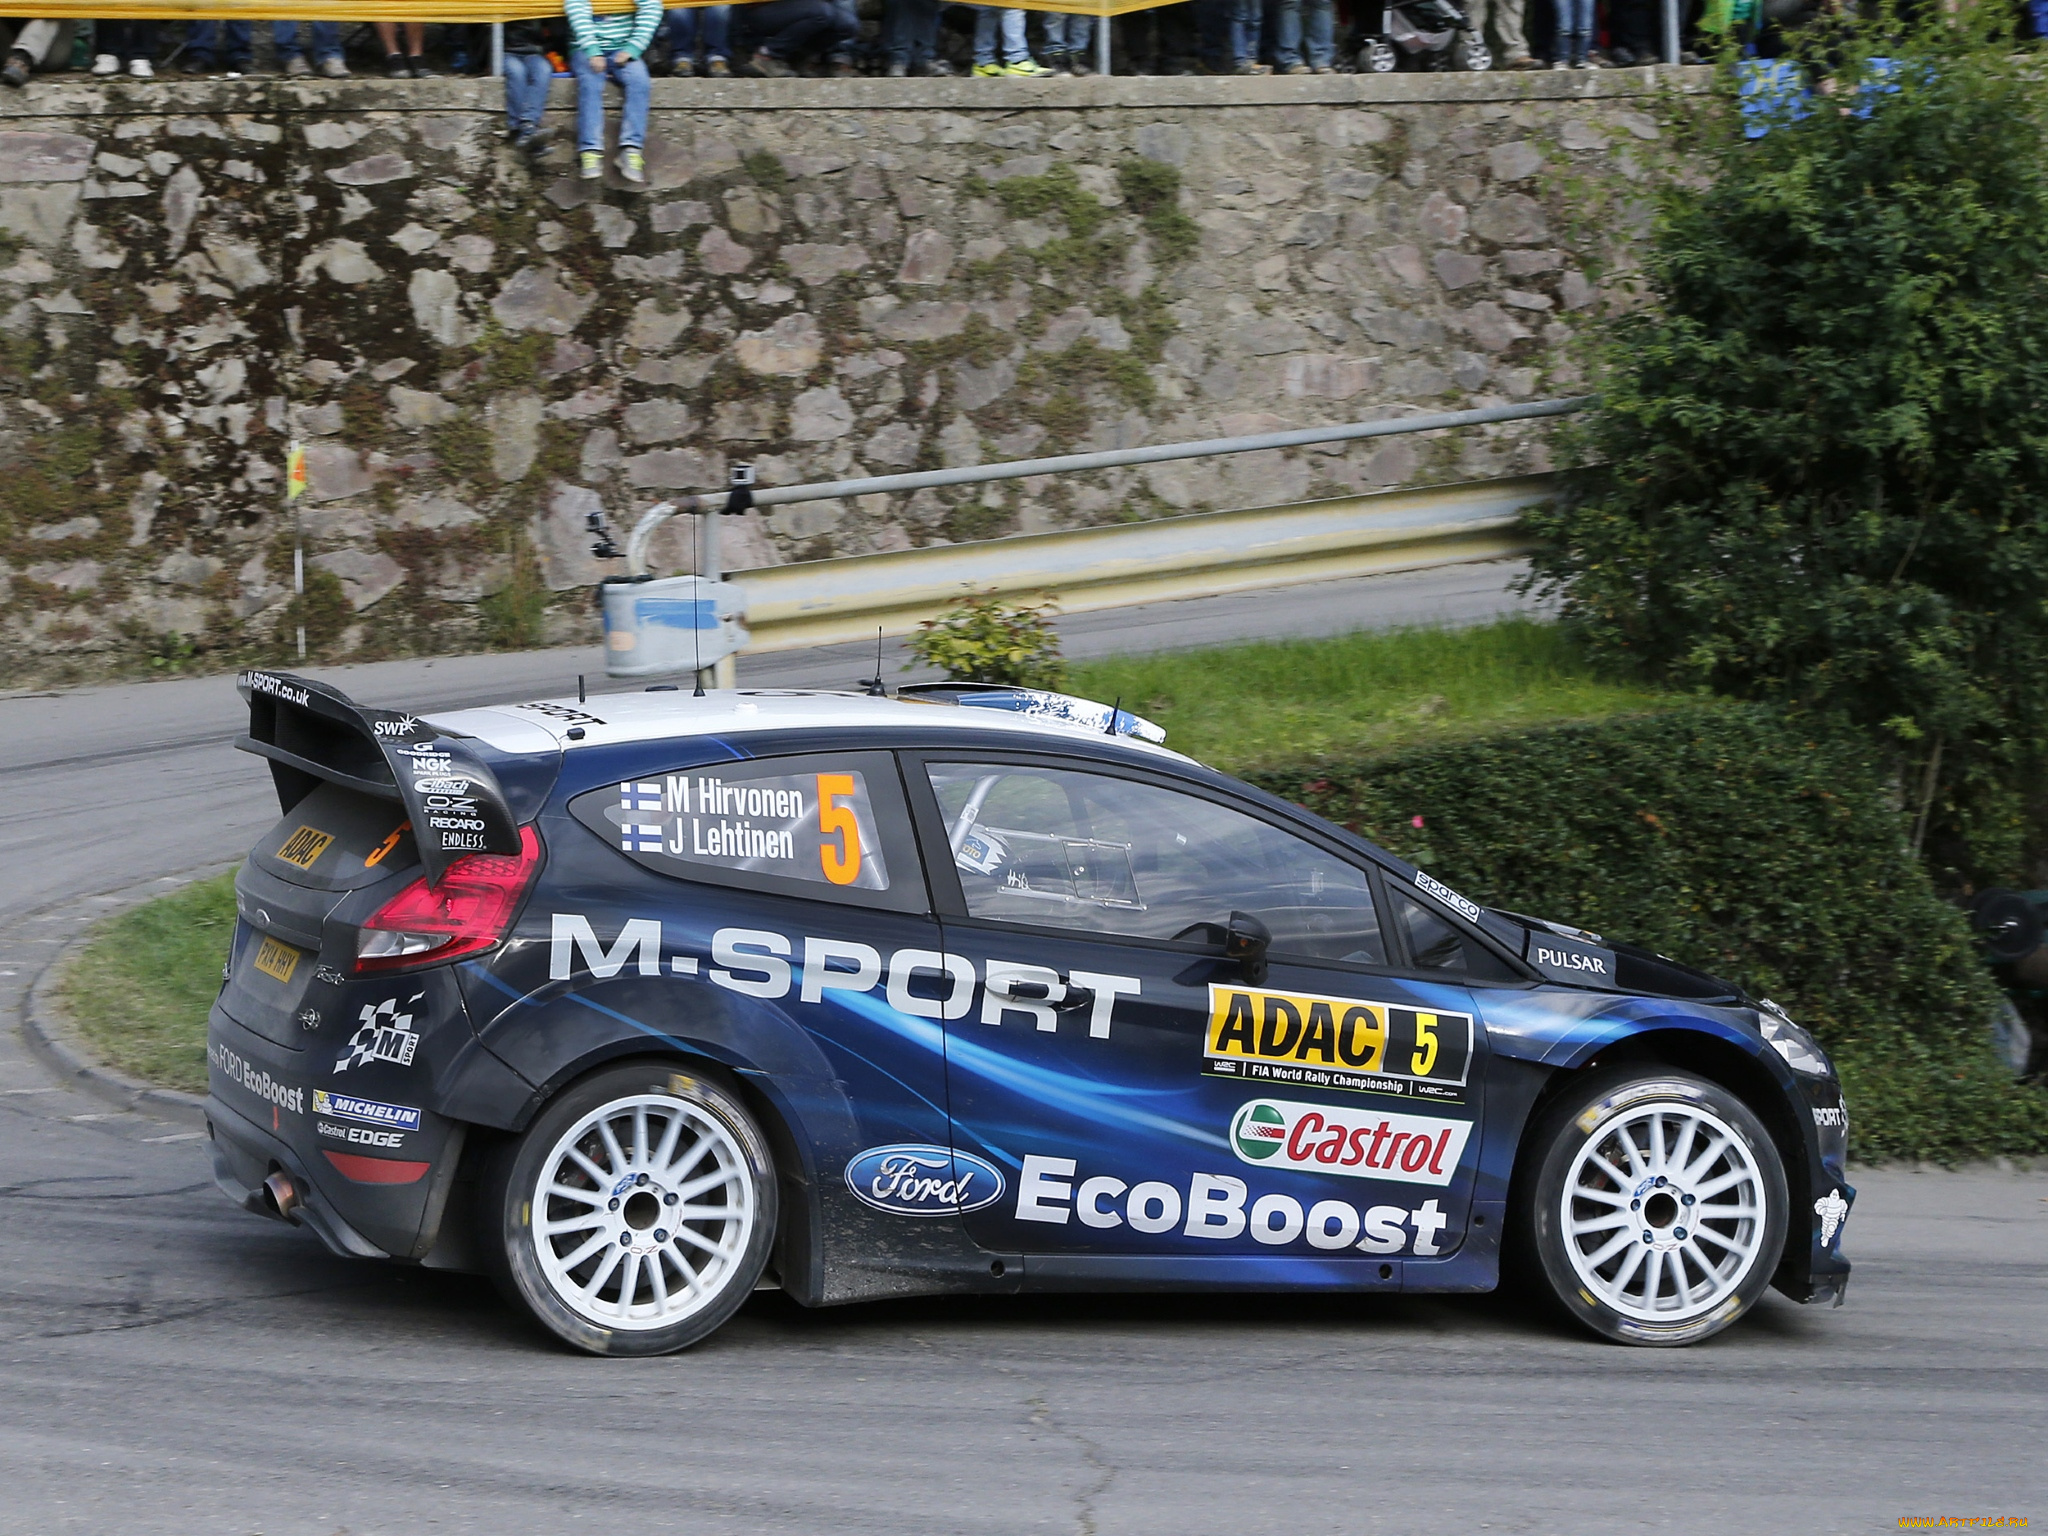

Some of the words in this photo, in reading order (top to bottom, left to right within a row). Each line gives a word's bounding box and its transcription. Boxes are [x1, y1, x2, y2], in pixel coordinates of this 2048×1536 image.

[374, 721, 409, 736] SWP
[412, 758, 452, 772] NGK
[414, 777, 470, 796] Eibach
[666, 775, 690, 813] M
[699, 777, 803, 819] Hirvonen
[430, 817, 485, 831] RECARO
[442, 832, 484, 848] ENDLESS
[669, 817, 684, 854] J
[693, 818, 794, 859] Lehtinen
[816, 773, 862, 885] 5
[279, 828, 328, 865] ADAC
[1417, 873, 1478, 918] sparco
[549, 913, 1142, 1039] M-SPORT
[1538, 948, 1607, 974] PULSAR
[403, 1034, 418, 1063] SPORT
[1216, 993, 1379, 1067] ADAC
[1410, 1012, 1439, 1076] 5
[220, 1043, 242, 1083] FORD
[243, 1060, 304, 1115] EcoBoost
[1252, 1065, 1270, 1077] FIA
[1272, 1067, 1302, 1081] World
[1305, 1071, 1330, 1085] Rally
[1333, 1073, 1403, 1094] Championship
[334, 1098, 418, 1123] MICHELIN
[323, 1123, 346, 1139] Castrol
[348, 1127, 405, 1148] EDGE
[1287, 1112, 1452, 1175] Castrol
[872, 1154, 970, 1206] Ford
[1015, 1154, 1448, 1256] EcoBoost
